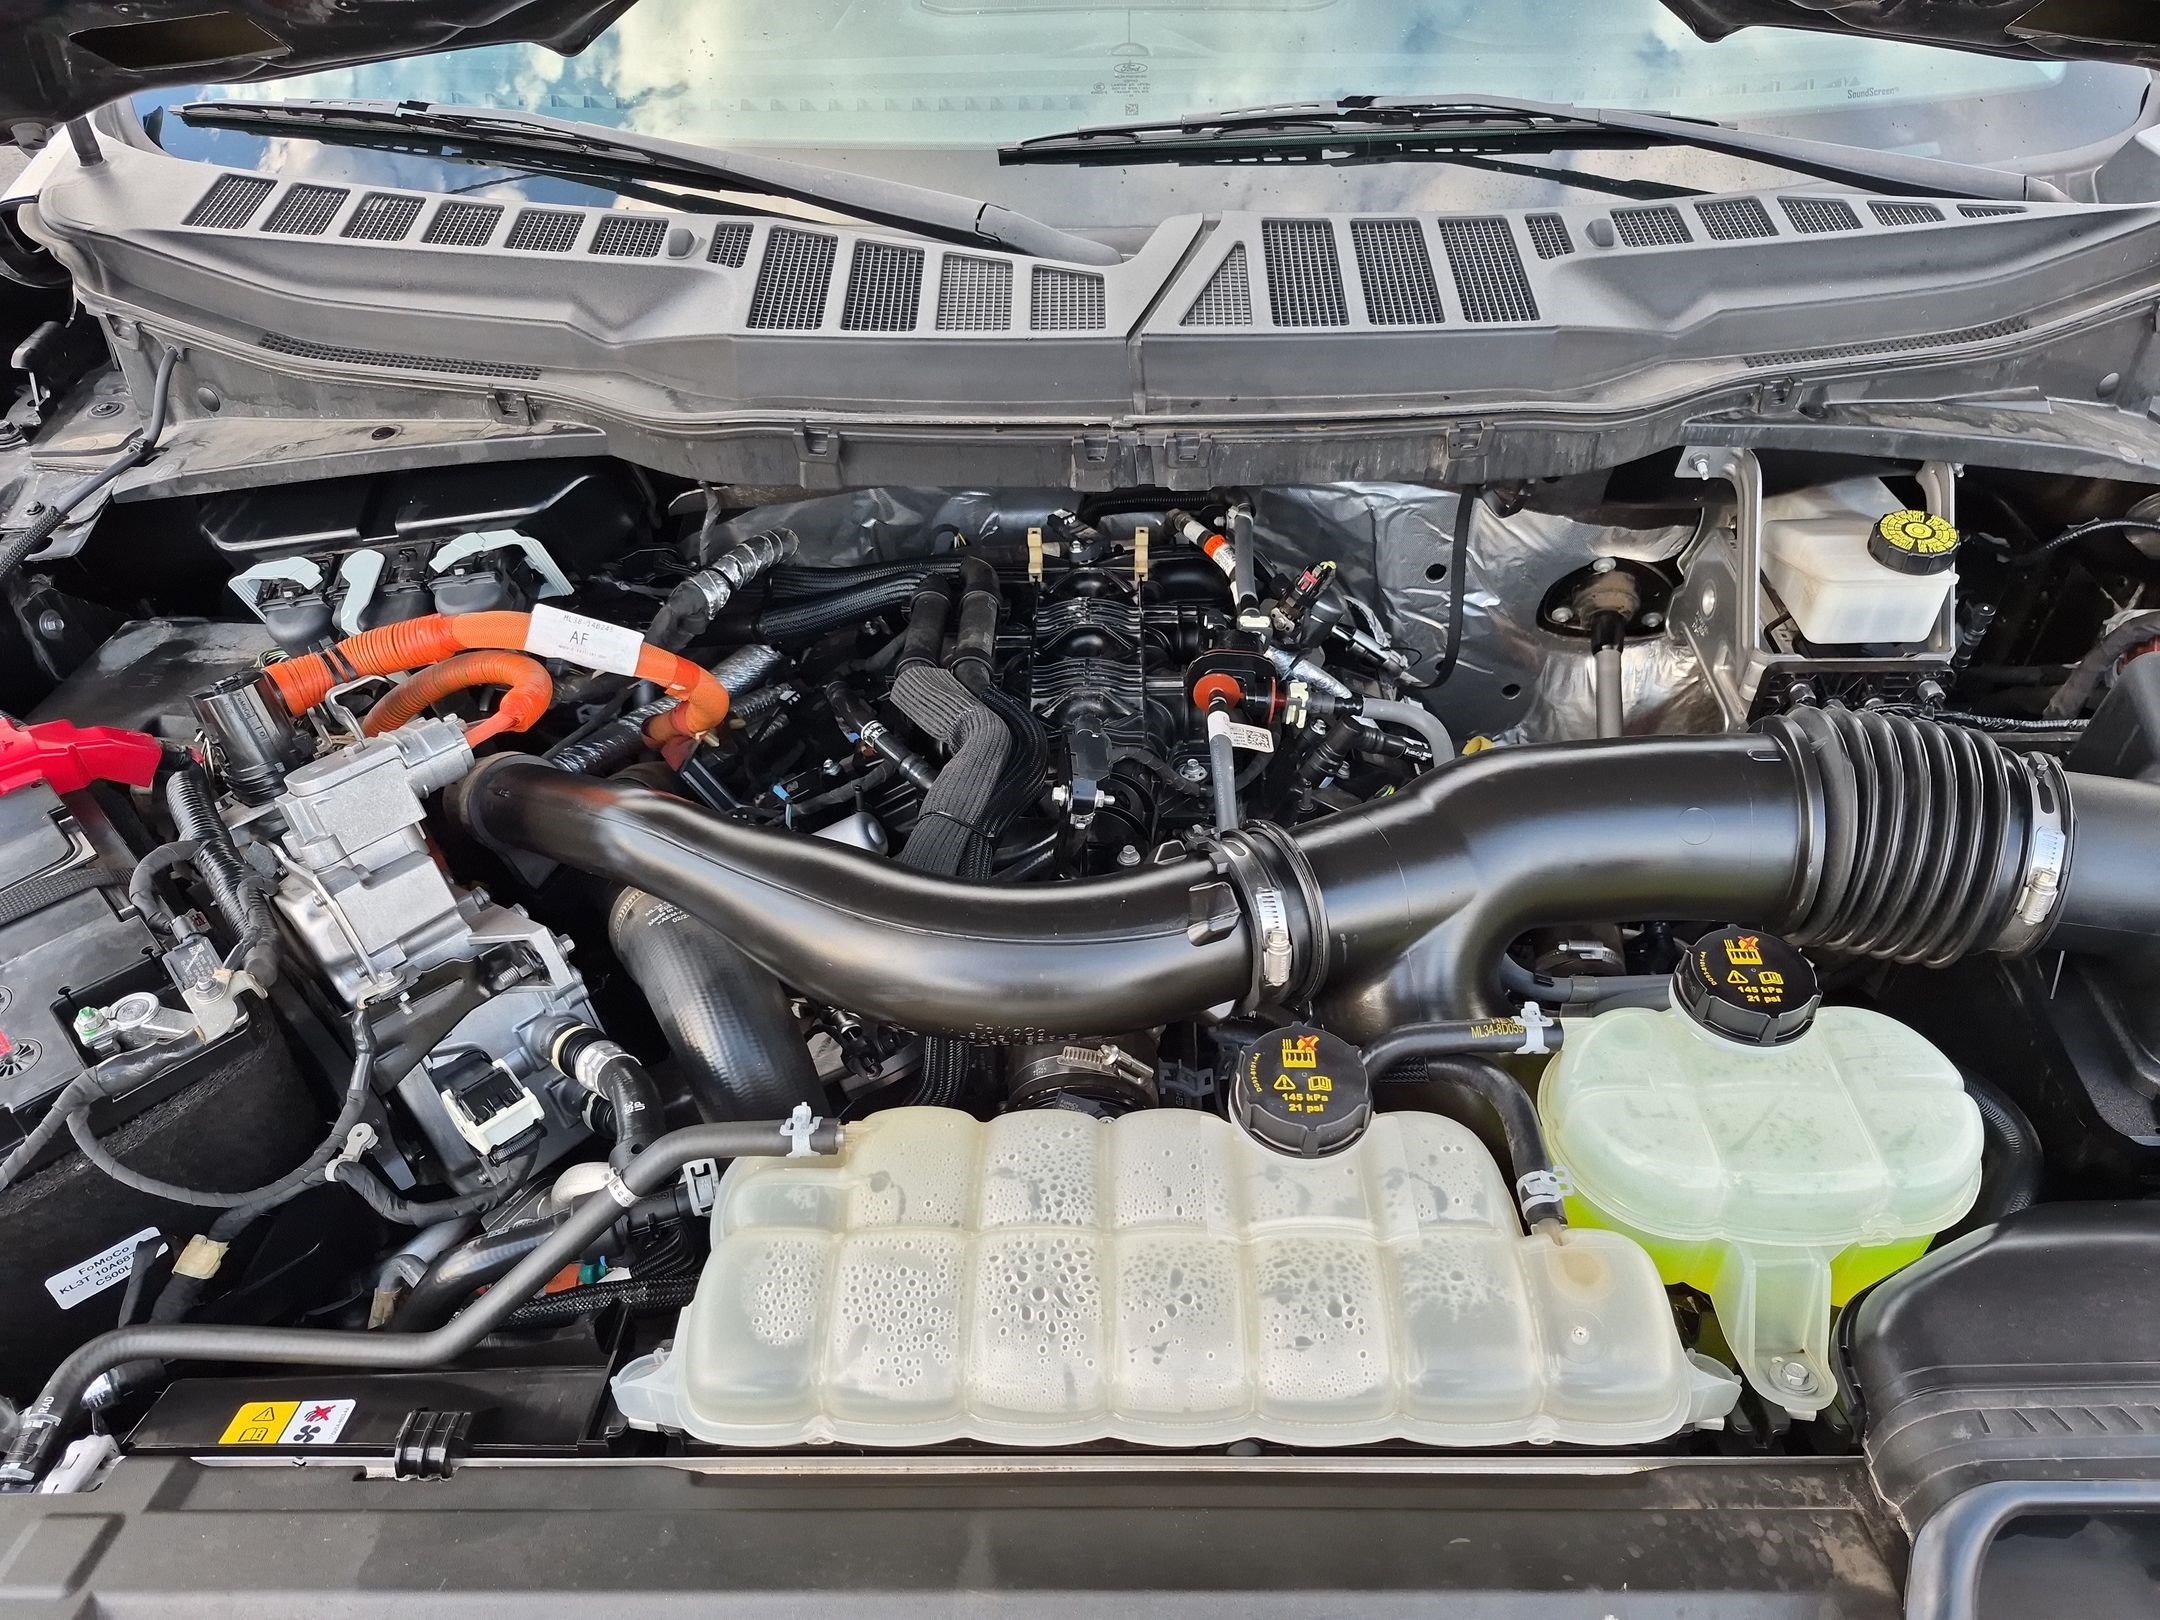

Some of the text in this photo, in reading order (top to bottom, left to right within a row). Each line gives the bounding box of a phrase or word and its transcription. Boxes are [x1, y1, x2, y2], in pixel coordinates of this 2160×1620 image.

[569, 630, 590, 646] AF
[1737, 985, 1783, 994] 145 kPa
[1746, 994, 1782, 1004] 21 psi
[1281, 1092, 1329, 1102] 145 kPa
[1288, 1103, 1324, 1113] 21 psi
[78, 1246, 130, 1275] FoMoCo
[59, 1275, 91, 1294] KL3T
[38, 1396, 55, 1414] RAD
